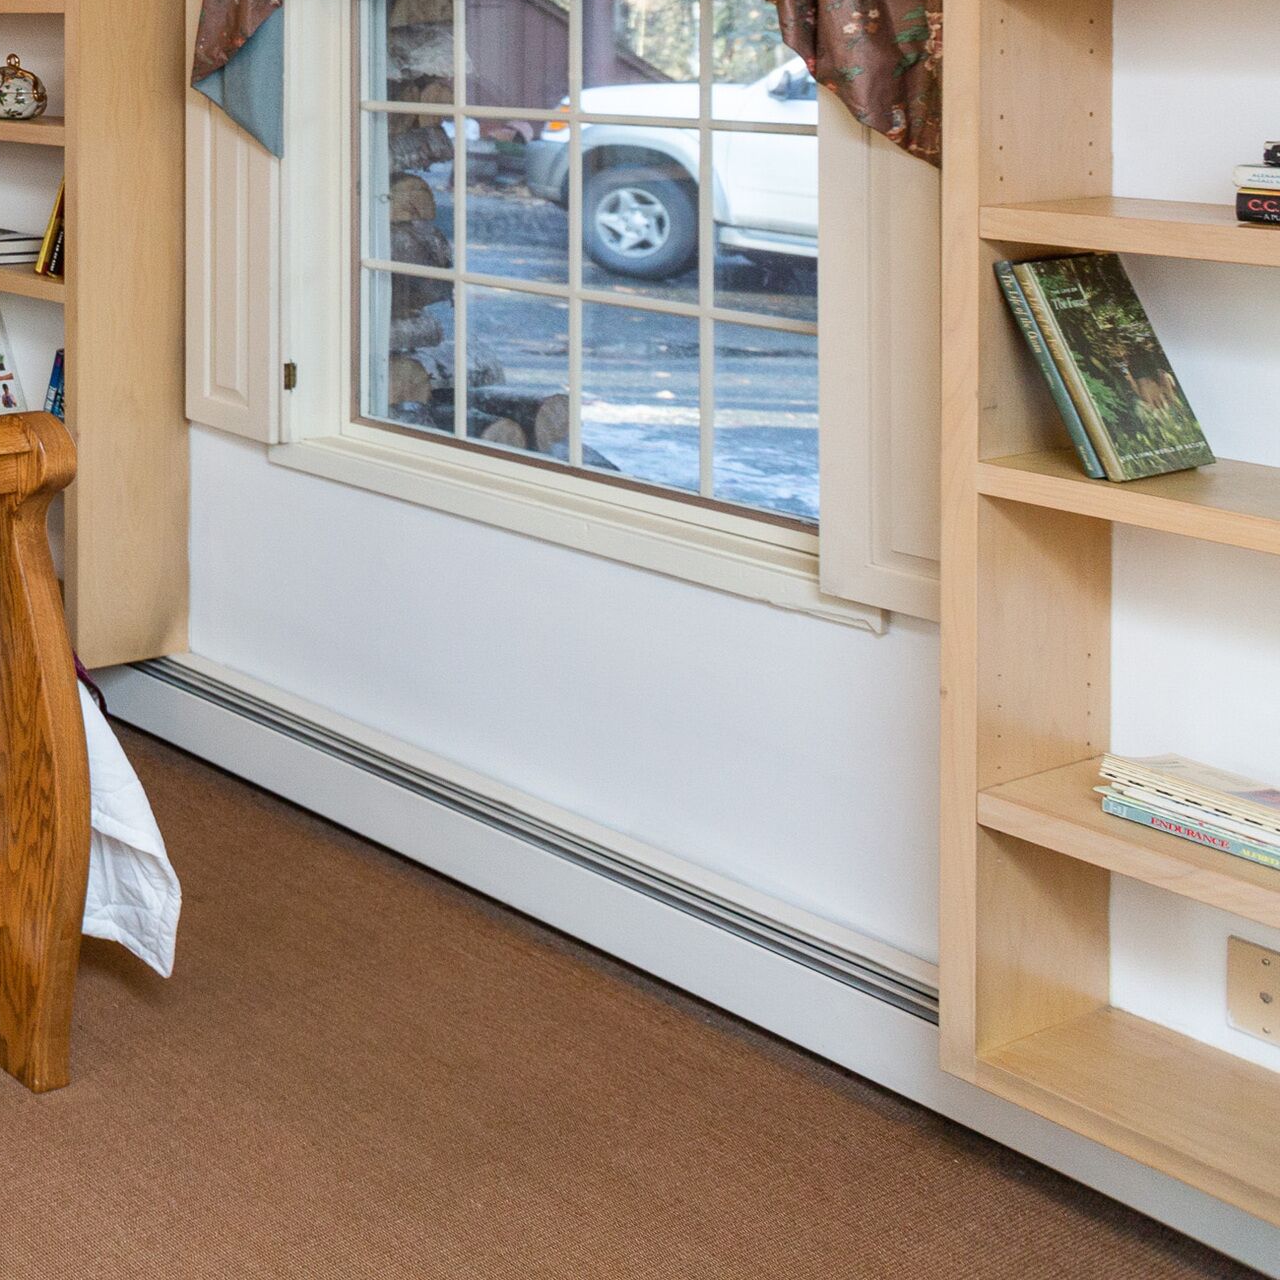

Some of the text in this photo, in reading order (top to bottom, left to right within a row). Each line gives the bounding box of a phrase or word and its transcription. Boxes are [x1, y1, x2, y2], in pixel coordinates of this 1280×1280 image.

[1000, 273, 1014, 289] The
[1007, 289, 1023, 307] Life
[1020, 316, 1034, 331] the
[1150, 816, 1230, 849] ENDURANCE
